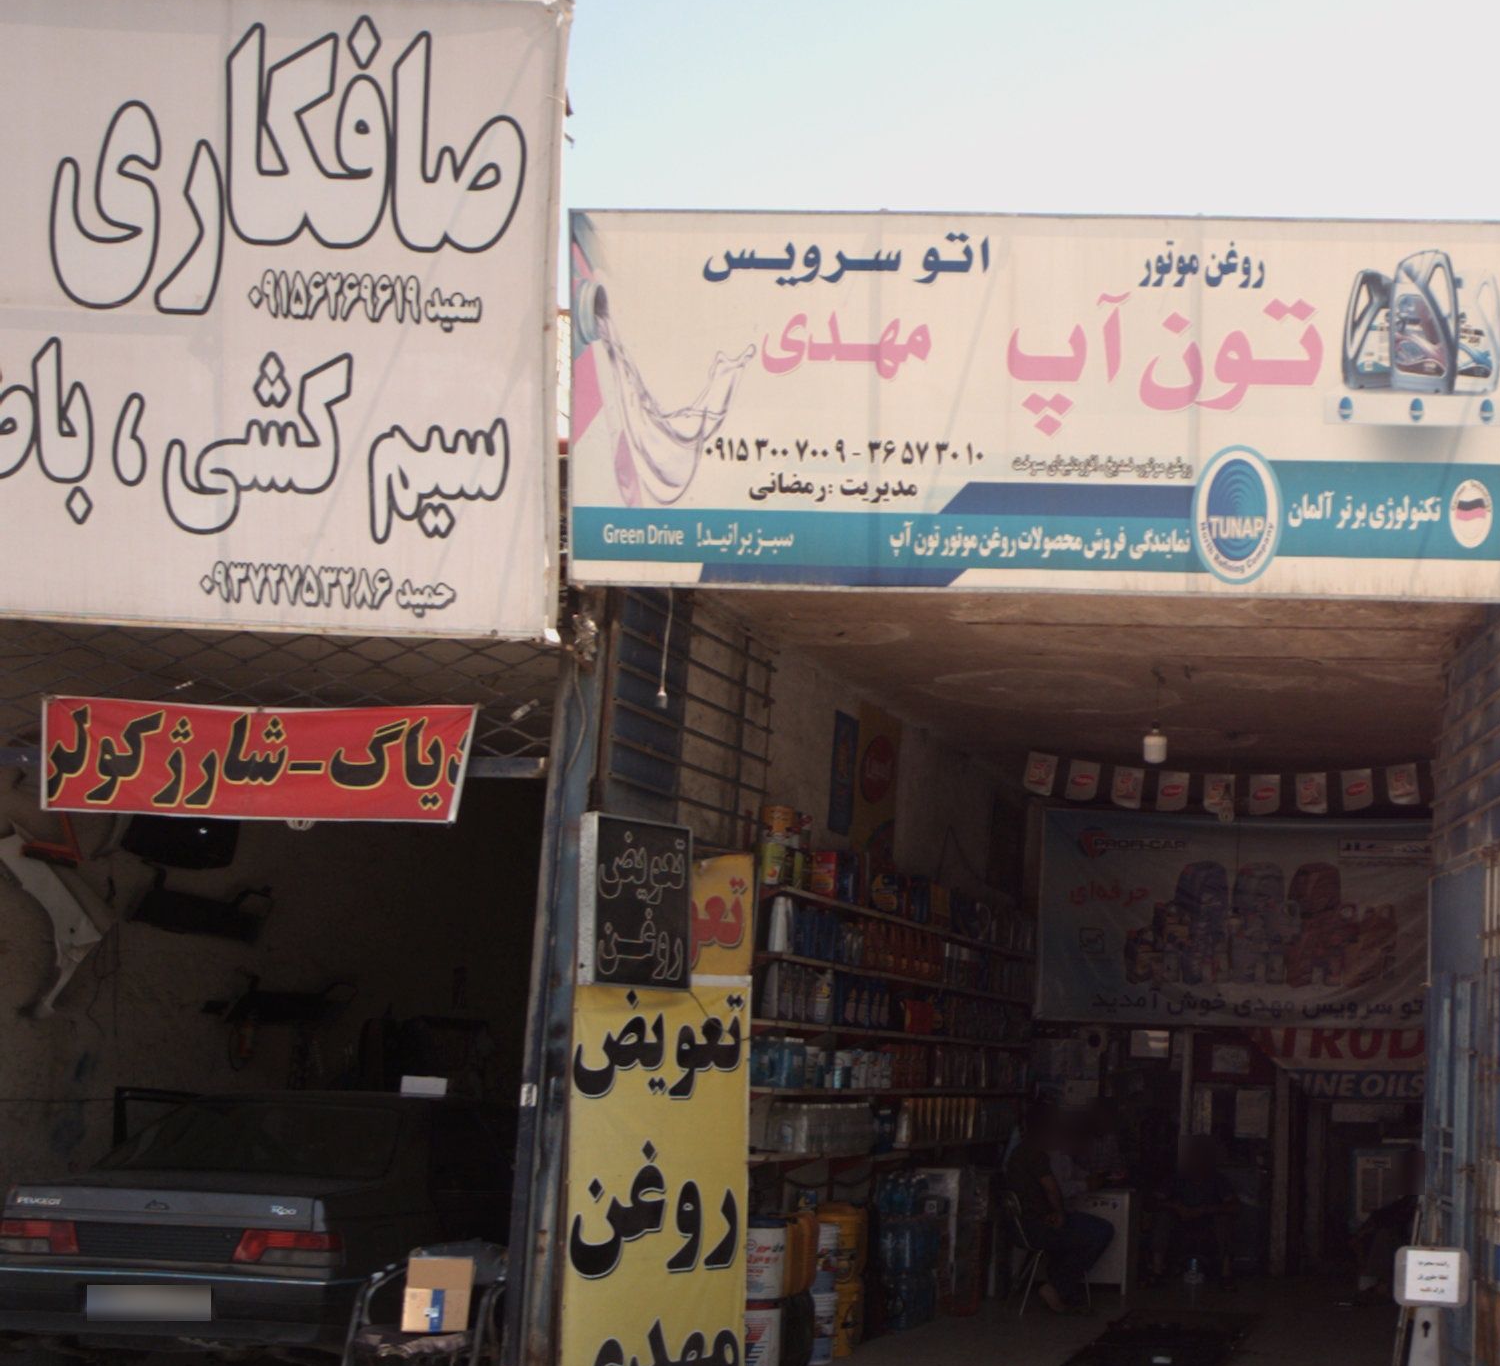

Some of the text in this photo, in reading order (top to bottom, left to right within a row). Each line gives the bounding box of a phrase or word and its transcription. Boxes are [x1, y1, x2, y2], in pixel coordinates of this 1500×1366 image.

[50, 15, 526, 314] صافکاری
[703, 232, 989, 286] اتو سرویس
[1138, 241, 1265, 288] روغن موتور
[248, 269, 481, 332] سعید ۰۹۱۵۶۲۶۹۶۱۹
[761, 310, 932, 379] مهدی
[1006, 291, 1325, 437] تون آپ
[163, 351, 353, 533] کشی
[367, 417, 510, 544] سیم
[839, 477, 918, 504] مدیریت
[603, 524, 686, 546] Green Drive
[1208, 516, 1265, 540] TUNAP
[1288, 491, 1335, 528] آلمان
[1336, 495, 1368, 530] برتر
[1368, 494, 1442, 531] تکنولوژی
[889, 521, 1192, 560] نمایندگی فروش محصولات روغن موتور تون آپ
[396, 578, 456, 618] حمید
[598, 830, 686, 906] تعویض
[597, 908, 684, 981] روغن
[572, 990, 746, 1100] تعویض
[17, 1196, 62, 1206] PEUGEOT
[569, 1140, 739, 1278] روغن
